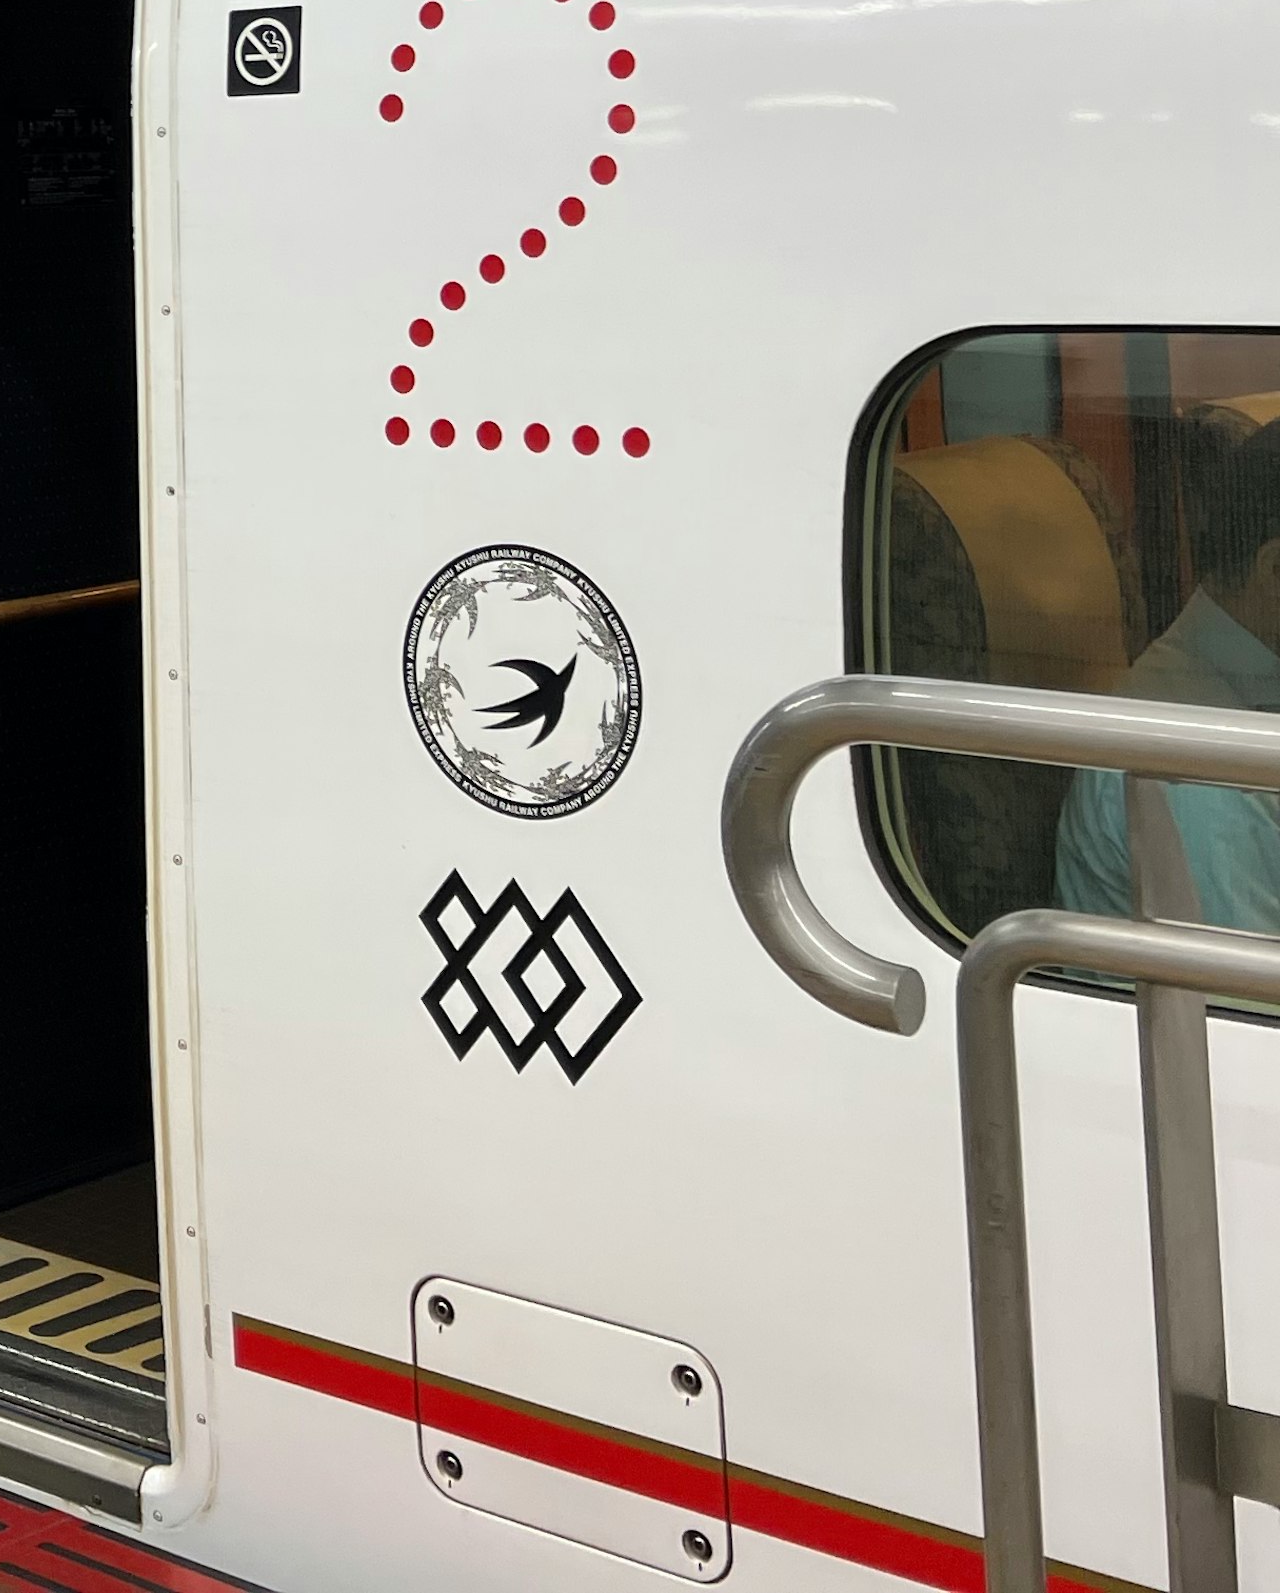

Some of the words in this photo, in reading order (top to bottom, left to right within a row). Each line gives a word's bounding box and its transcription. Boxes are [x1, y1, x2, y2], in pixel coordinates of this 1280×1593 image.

[406, 618, 422, 660] AROUND
[416, 598, 430, 618] THE
[426, 568, 455, 600] KYUSHU
[454, 550, 490, 573] KYUSHU
[490, 549, 532, 559] RAILWAY
[533, 552, 578, 579] COMPANY
[577, 576, 611, 614] KYUSHU
[607, 612, 631, 655] LIMITED
[626, 656, 640, 707] EXPRESS
[462, 779, 498, 807] KYUSHU
[498, 800, 539, 817] RAILWAY
[540, 797, 583, 817] COMPANY
[583, 771, 615, 801] AROUND
[614, 751, 627, 771] THE
[622, 709, 639, 753] KYUSHU
